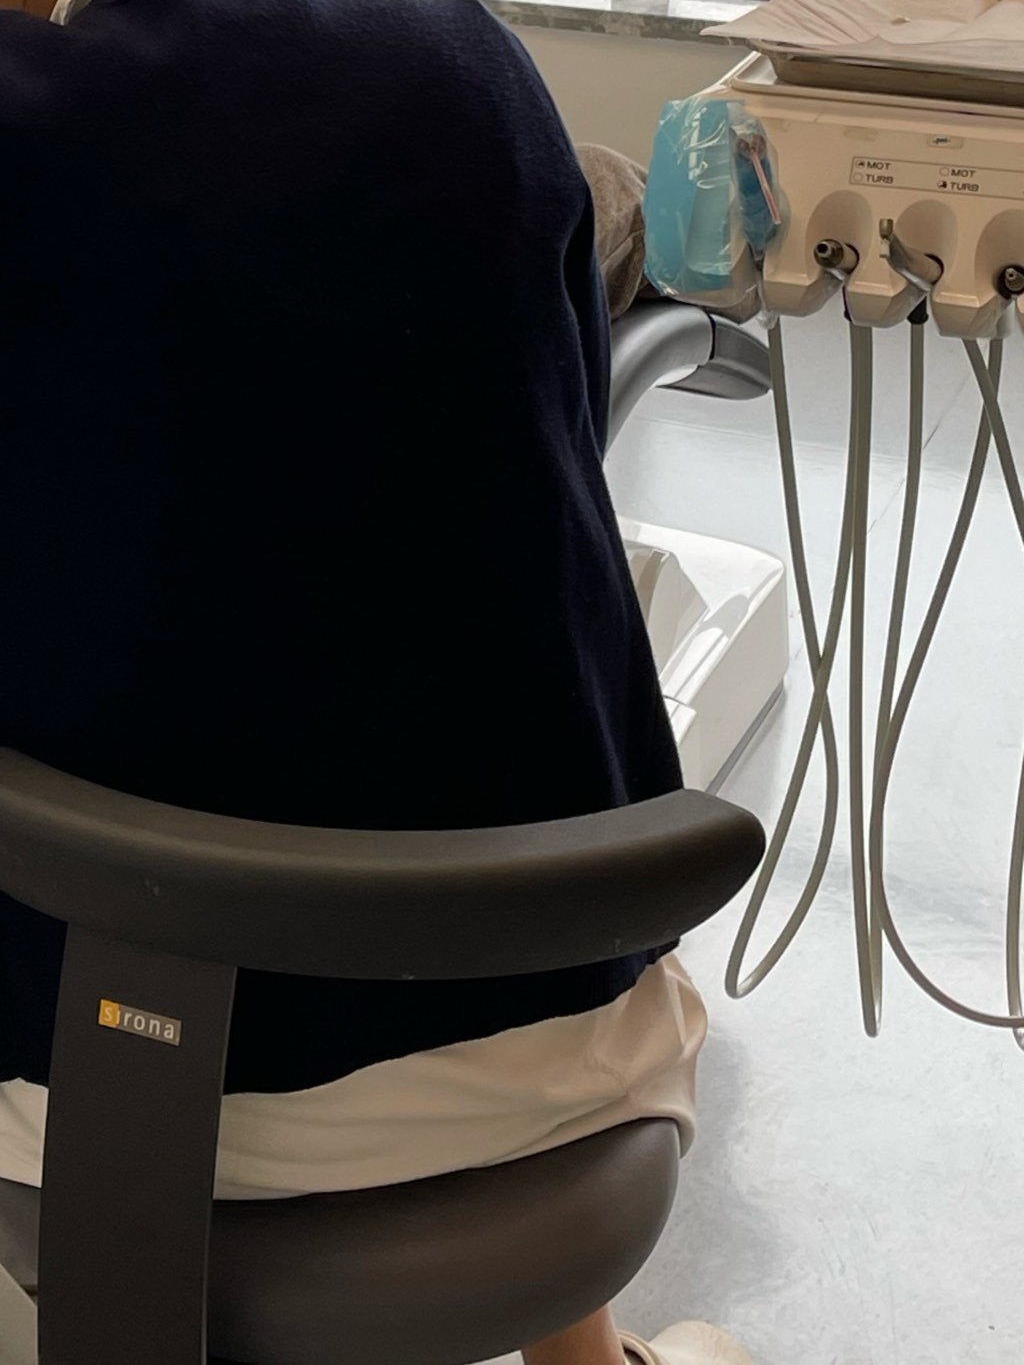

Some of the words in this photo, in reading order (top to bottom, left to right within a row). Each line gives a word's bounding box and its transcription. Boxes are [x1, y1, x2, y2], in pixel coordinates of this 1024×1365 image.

[866, 161, 891, 170] MOT
[951, 168, 976, 178] MOT
[866, 173, 894, 185] TURB
[950, 182, 980, 192] TURB
